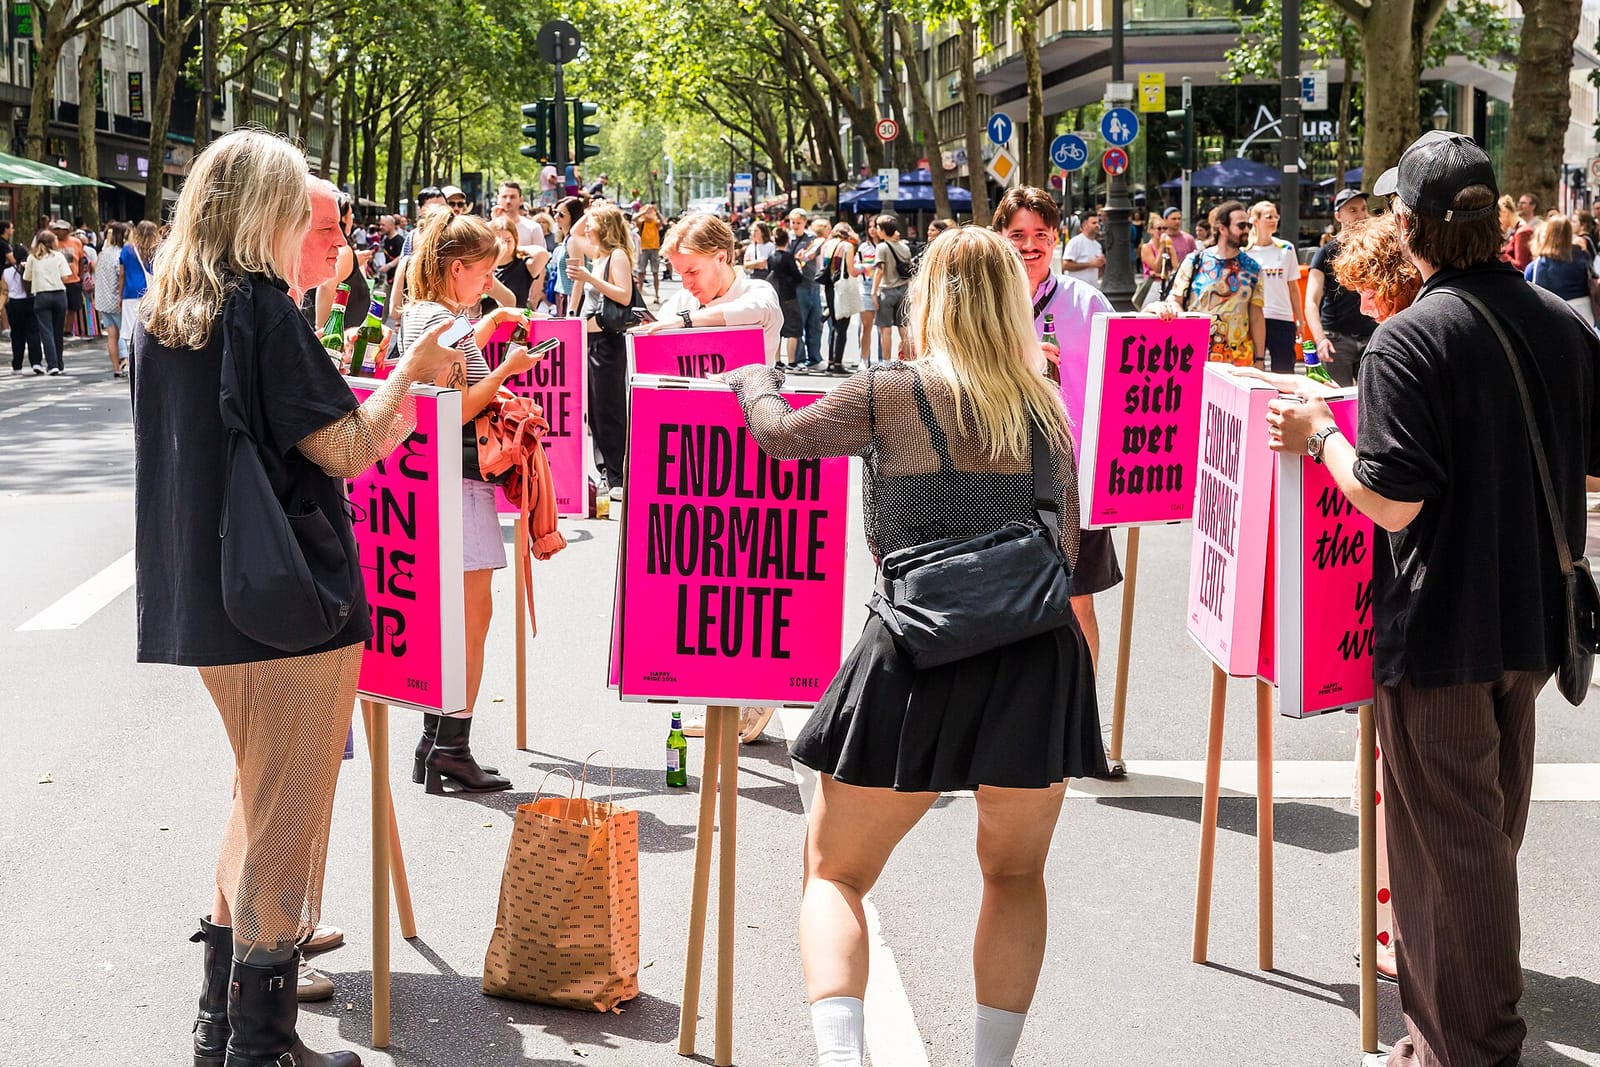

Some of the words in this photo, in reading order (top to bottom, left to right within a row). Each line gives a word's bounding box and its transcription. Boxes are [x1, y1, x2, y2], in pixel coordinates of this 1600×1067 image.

[881, 124, 893, 135] 30
[1119, 334, 1194, 374] Liebe
[1124, 375, 1182, 414] sich
[657, 424, 820, 500] ENDLICH
[1121, 424, 1178, 455] wer
[1205, 401, 1241, 484] ENDLICH
[1108, 457, 1183, 496] kann
[1198, 468, 1238, 557] NORMALE
[647, 503, 827, 580] NORMALE
[1312, 522, 1367, 570] the
[1200, 541, 1227, 622] LEUTE
[676, 584, 792, 658] LEUTE
[790, 677, 819, 688] SCHEE
